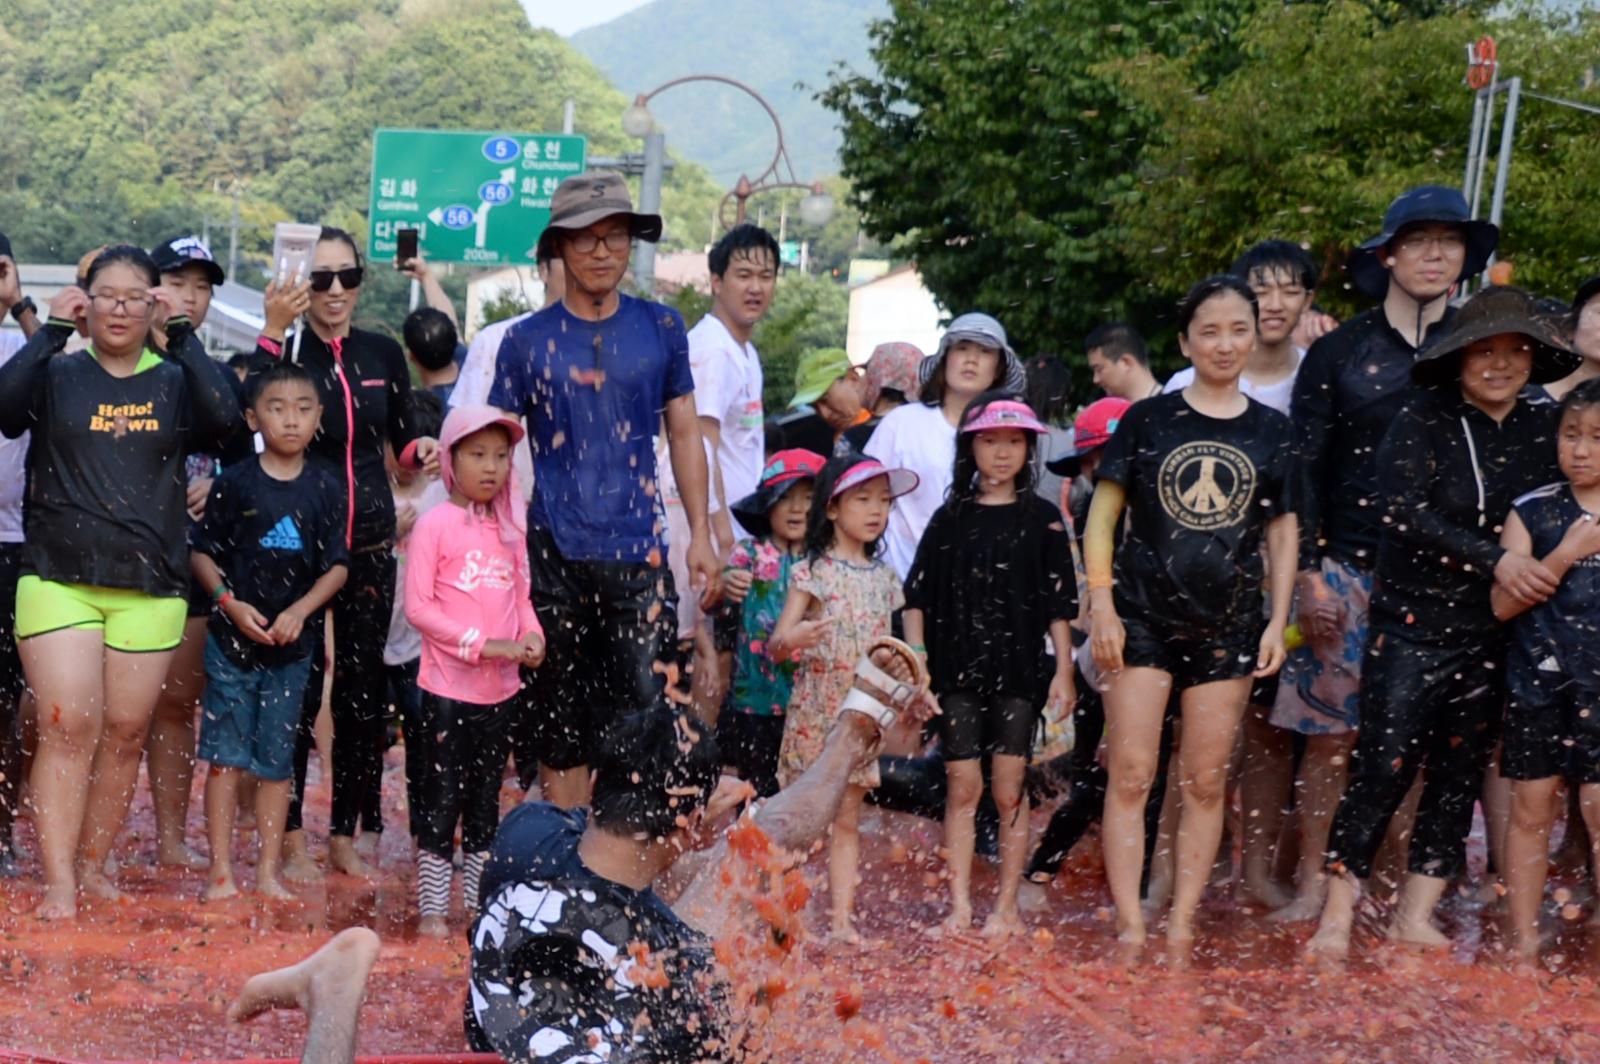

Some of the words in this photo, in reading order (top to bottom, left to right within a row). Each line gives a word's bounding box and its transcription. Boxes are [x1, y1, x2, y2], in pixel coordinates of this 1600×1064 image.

[496, 141, 507, 157] 5
[485, 185, 507, 200] 56
[447, 209, 468, 225] 56
[464, 247, 498, 260] 200m
[98, 402, 154, 418] Hello!
[90, 415, 159, 433] Brwn
